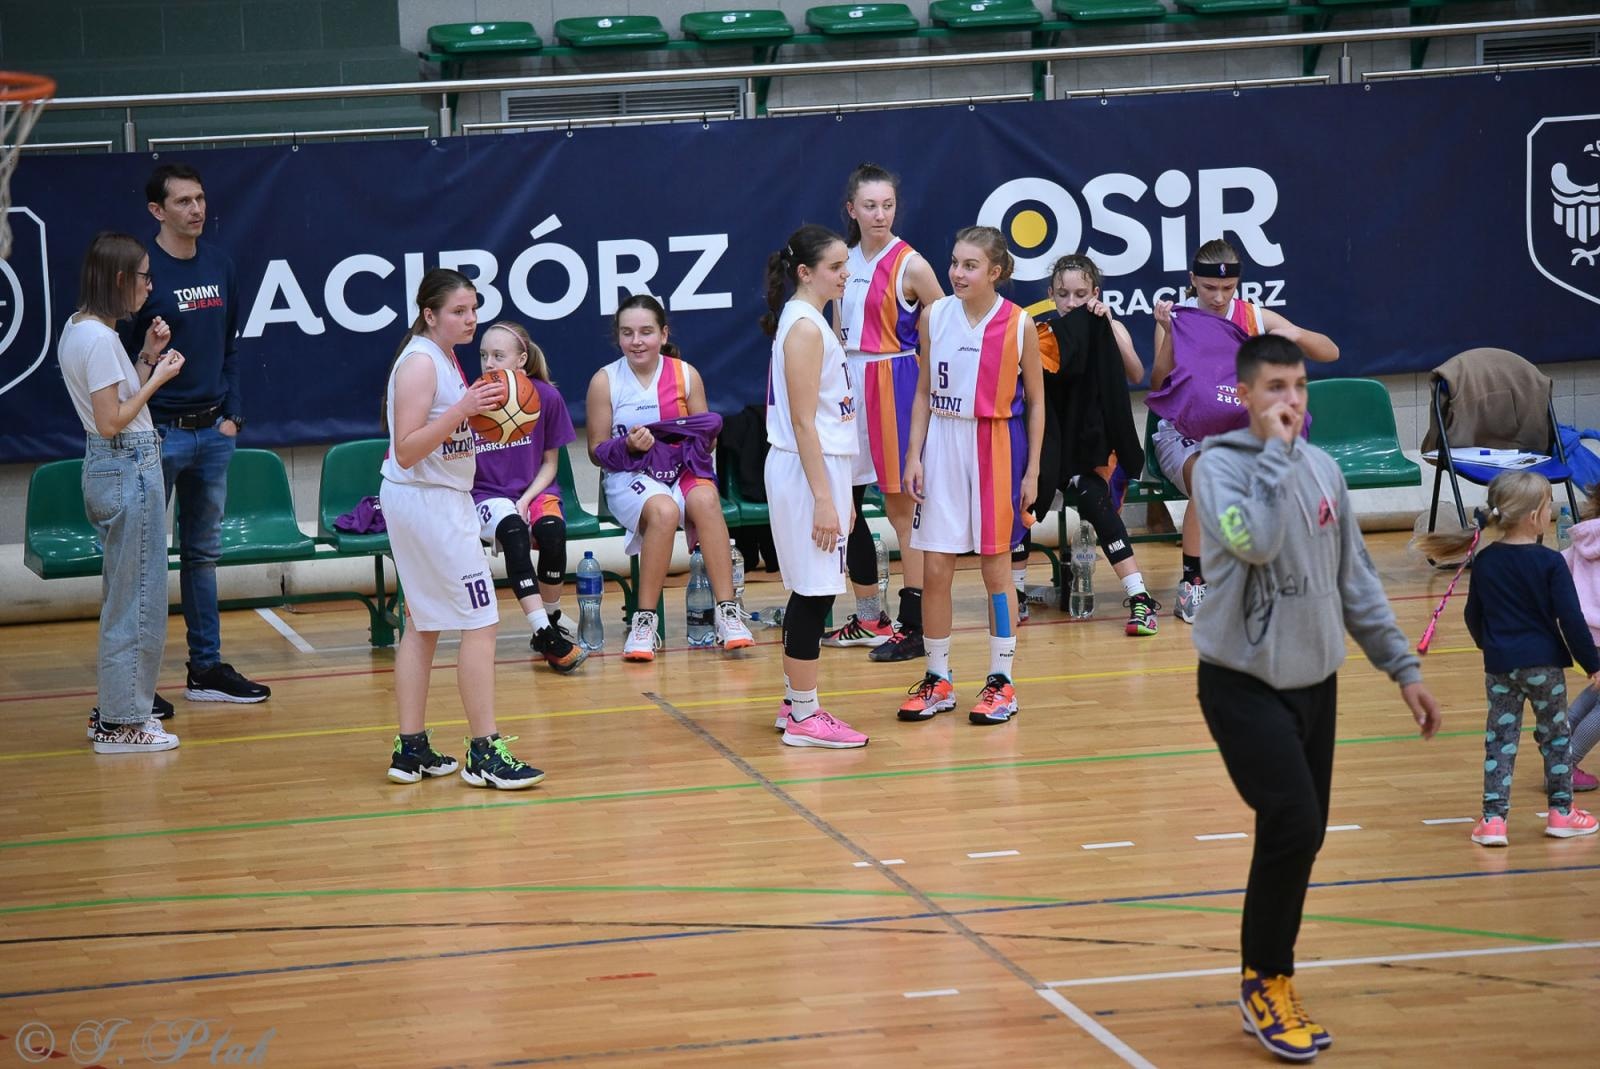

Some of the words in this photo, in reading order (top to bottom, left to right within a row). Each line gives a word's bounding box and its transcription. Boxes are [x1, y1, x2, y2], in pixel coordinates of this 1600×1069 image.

[976, 167, 1285, 281] OSiR
[235, 213, 733, 339] ACIBÓRZ
[173, 284, 219, 302] TOMMY
[195, 297, 224, 309] JEANS
[938, 361, 949, 389] 5
[631, 480, 646, 495] 9
[912, 503, 922, 530] 5
[465, 579, 490, 609] 18
